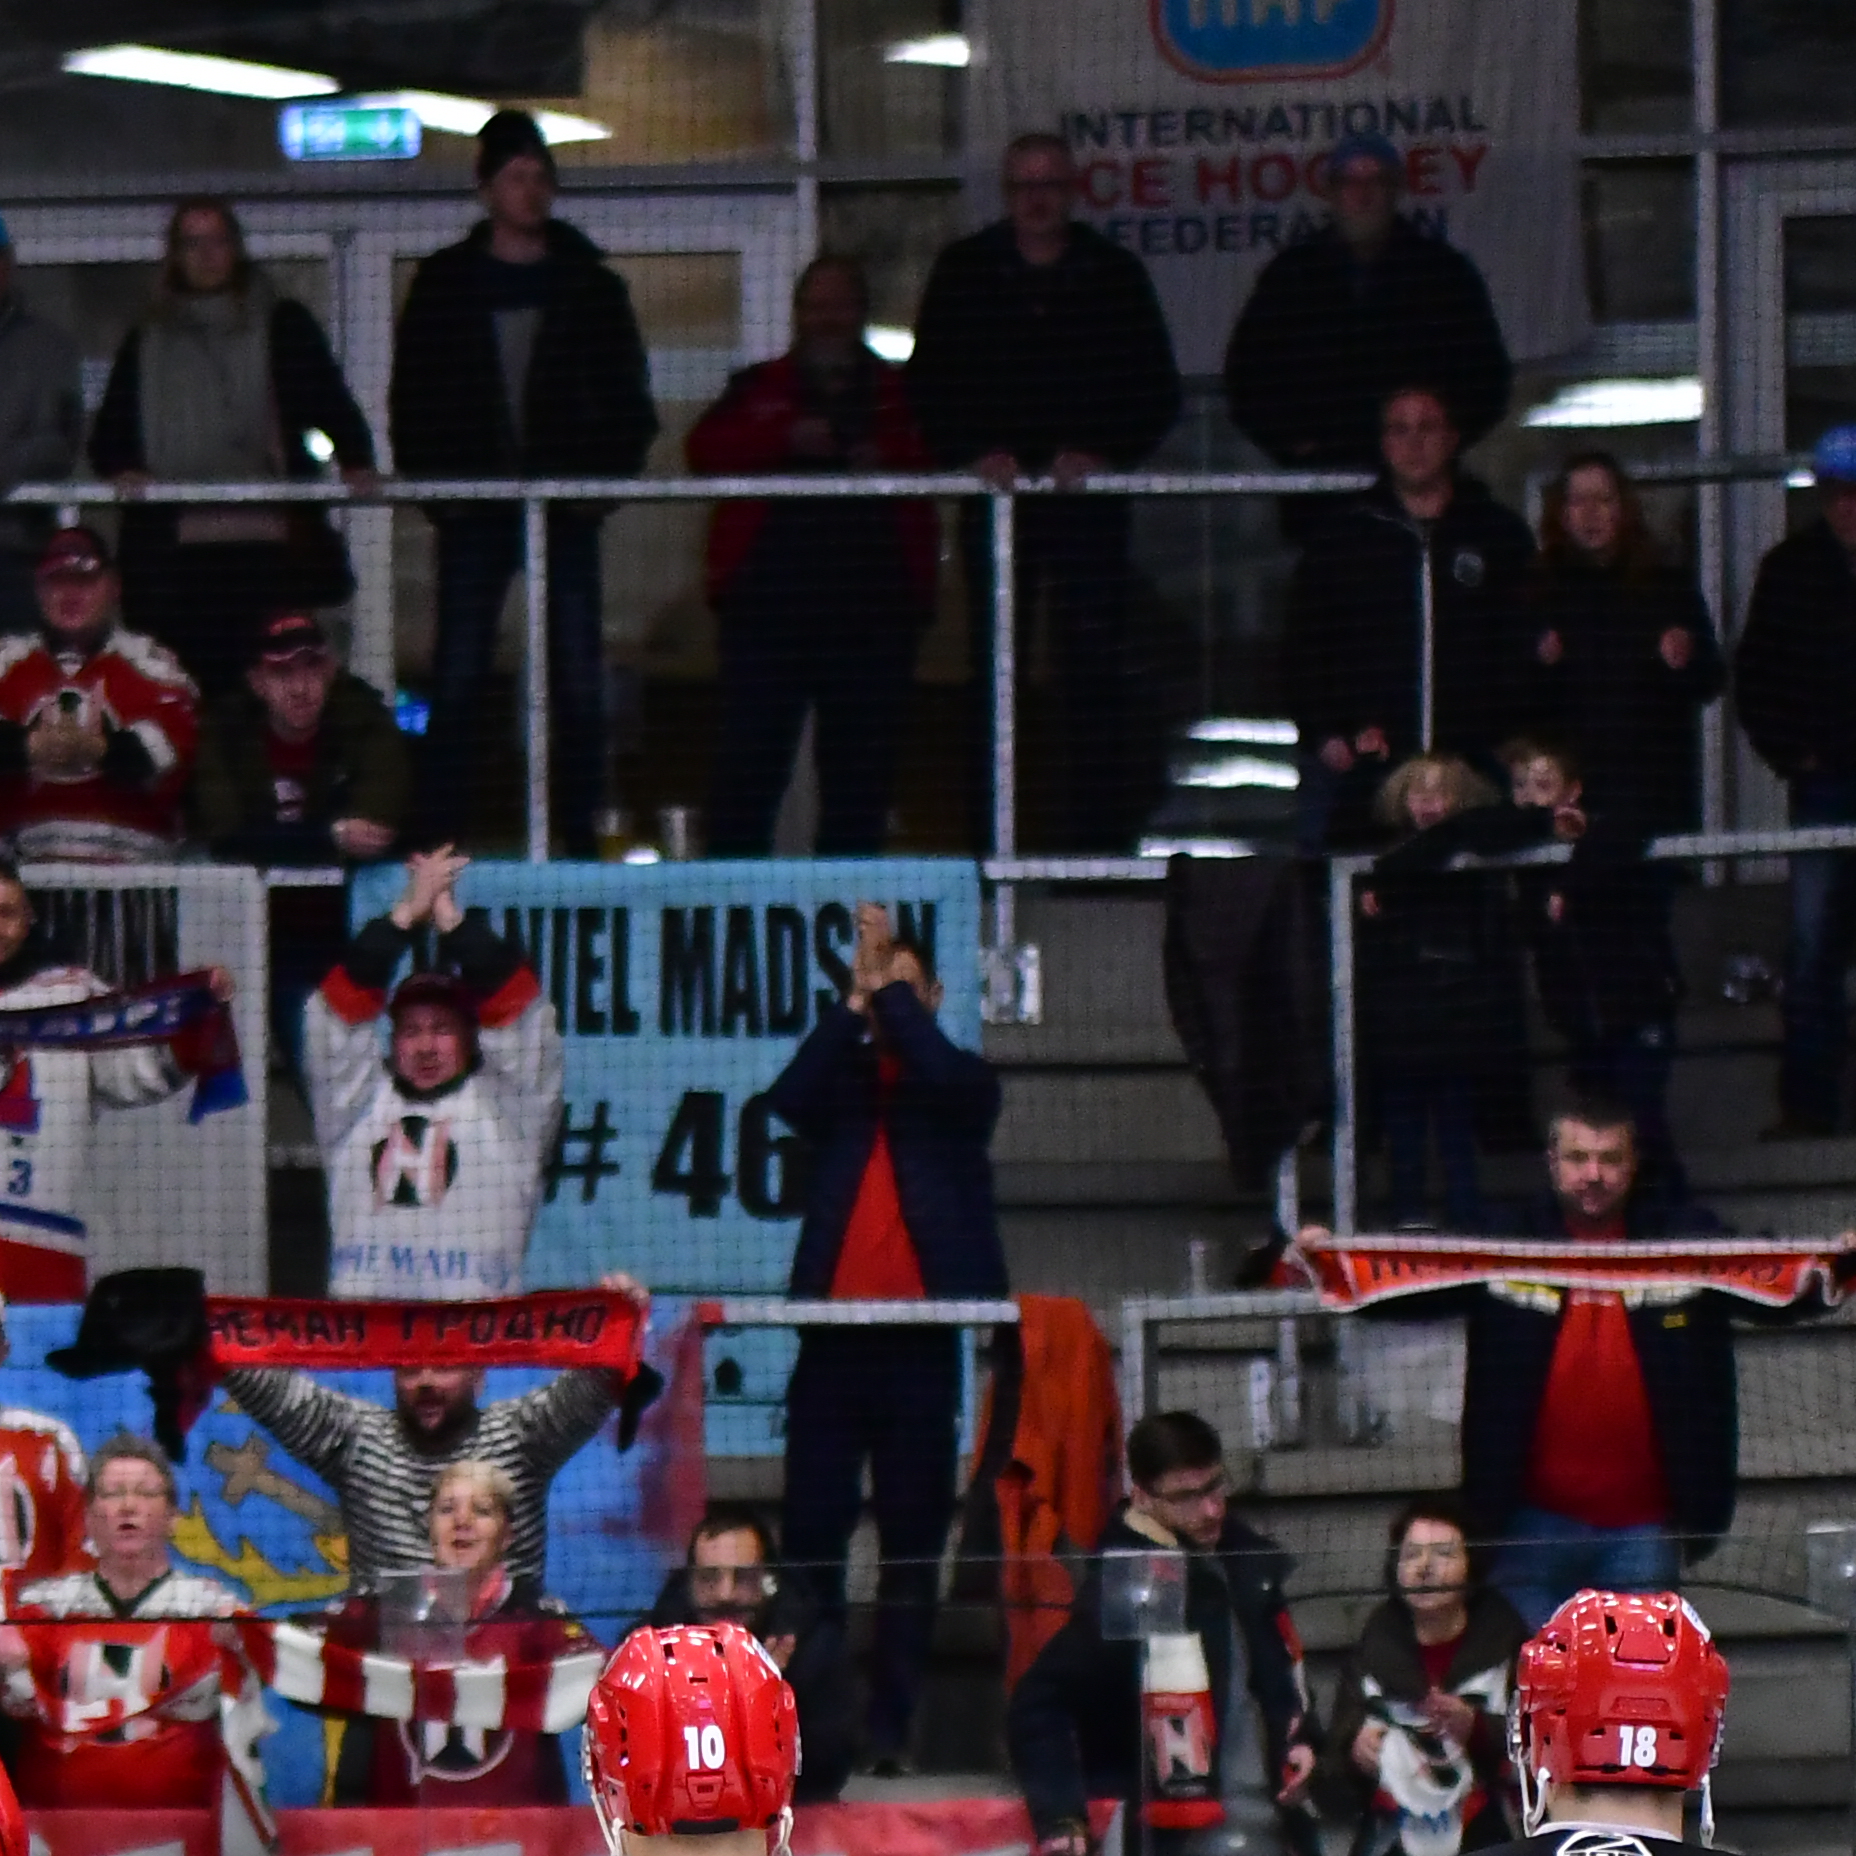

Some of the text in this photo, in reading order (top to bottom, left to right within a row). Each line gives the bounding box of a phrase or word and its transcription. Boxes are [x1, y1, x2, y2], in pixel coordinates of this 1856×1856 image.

[1062, 97, 1486, 147] INTERNATIONAL
[1079, 156, 1170, 207] CE
[398, 1304, 608, 1344] ГРОДНО
[683, 1725, 726, 1770] 10
[1618, 1724, 1658, 1767] 18
